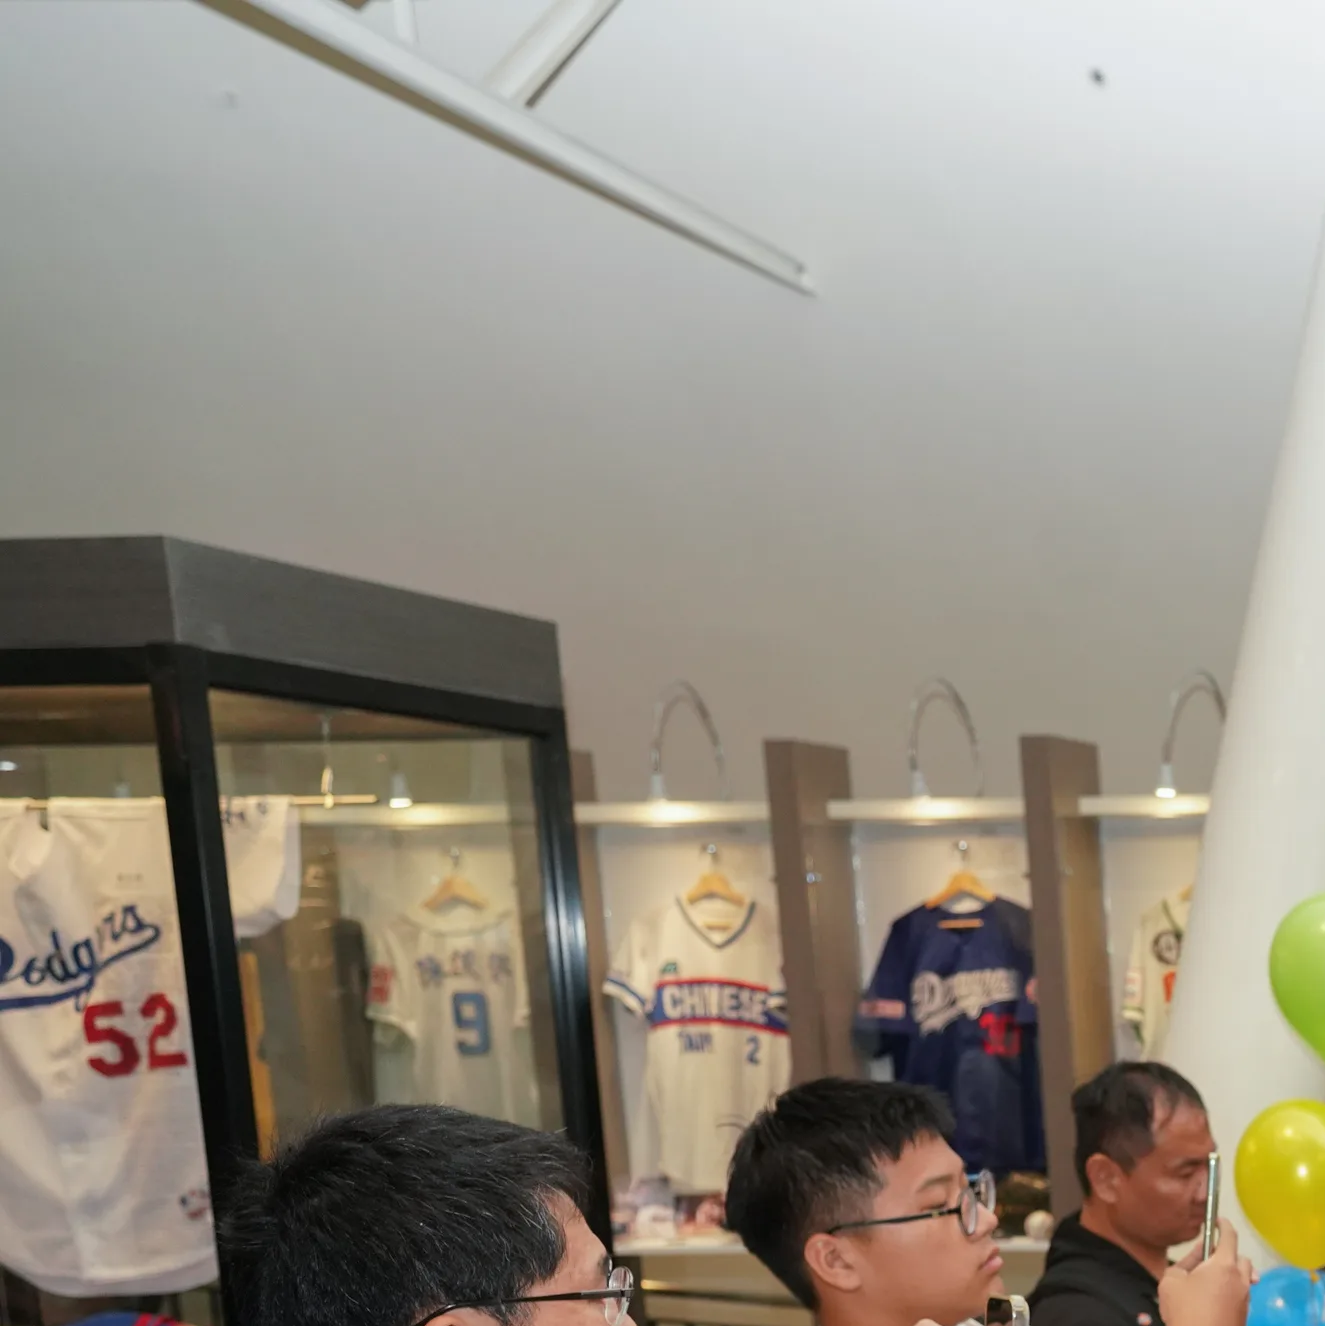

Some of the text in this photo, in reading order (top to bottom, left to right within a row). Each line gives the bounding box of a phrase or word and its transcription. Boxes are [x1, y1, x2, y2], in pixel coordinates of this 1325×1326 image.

[83, 992, 188, 1079] 52
[453, 992, 490, 1055] 9
[746, 1036, 761, 1065] 2
